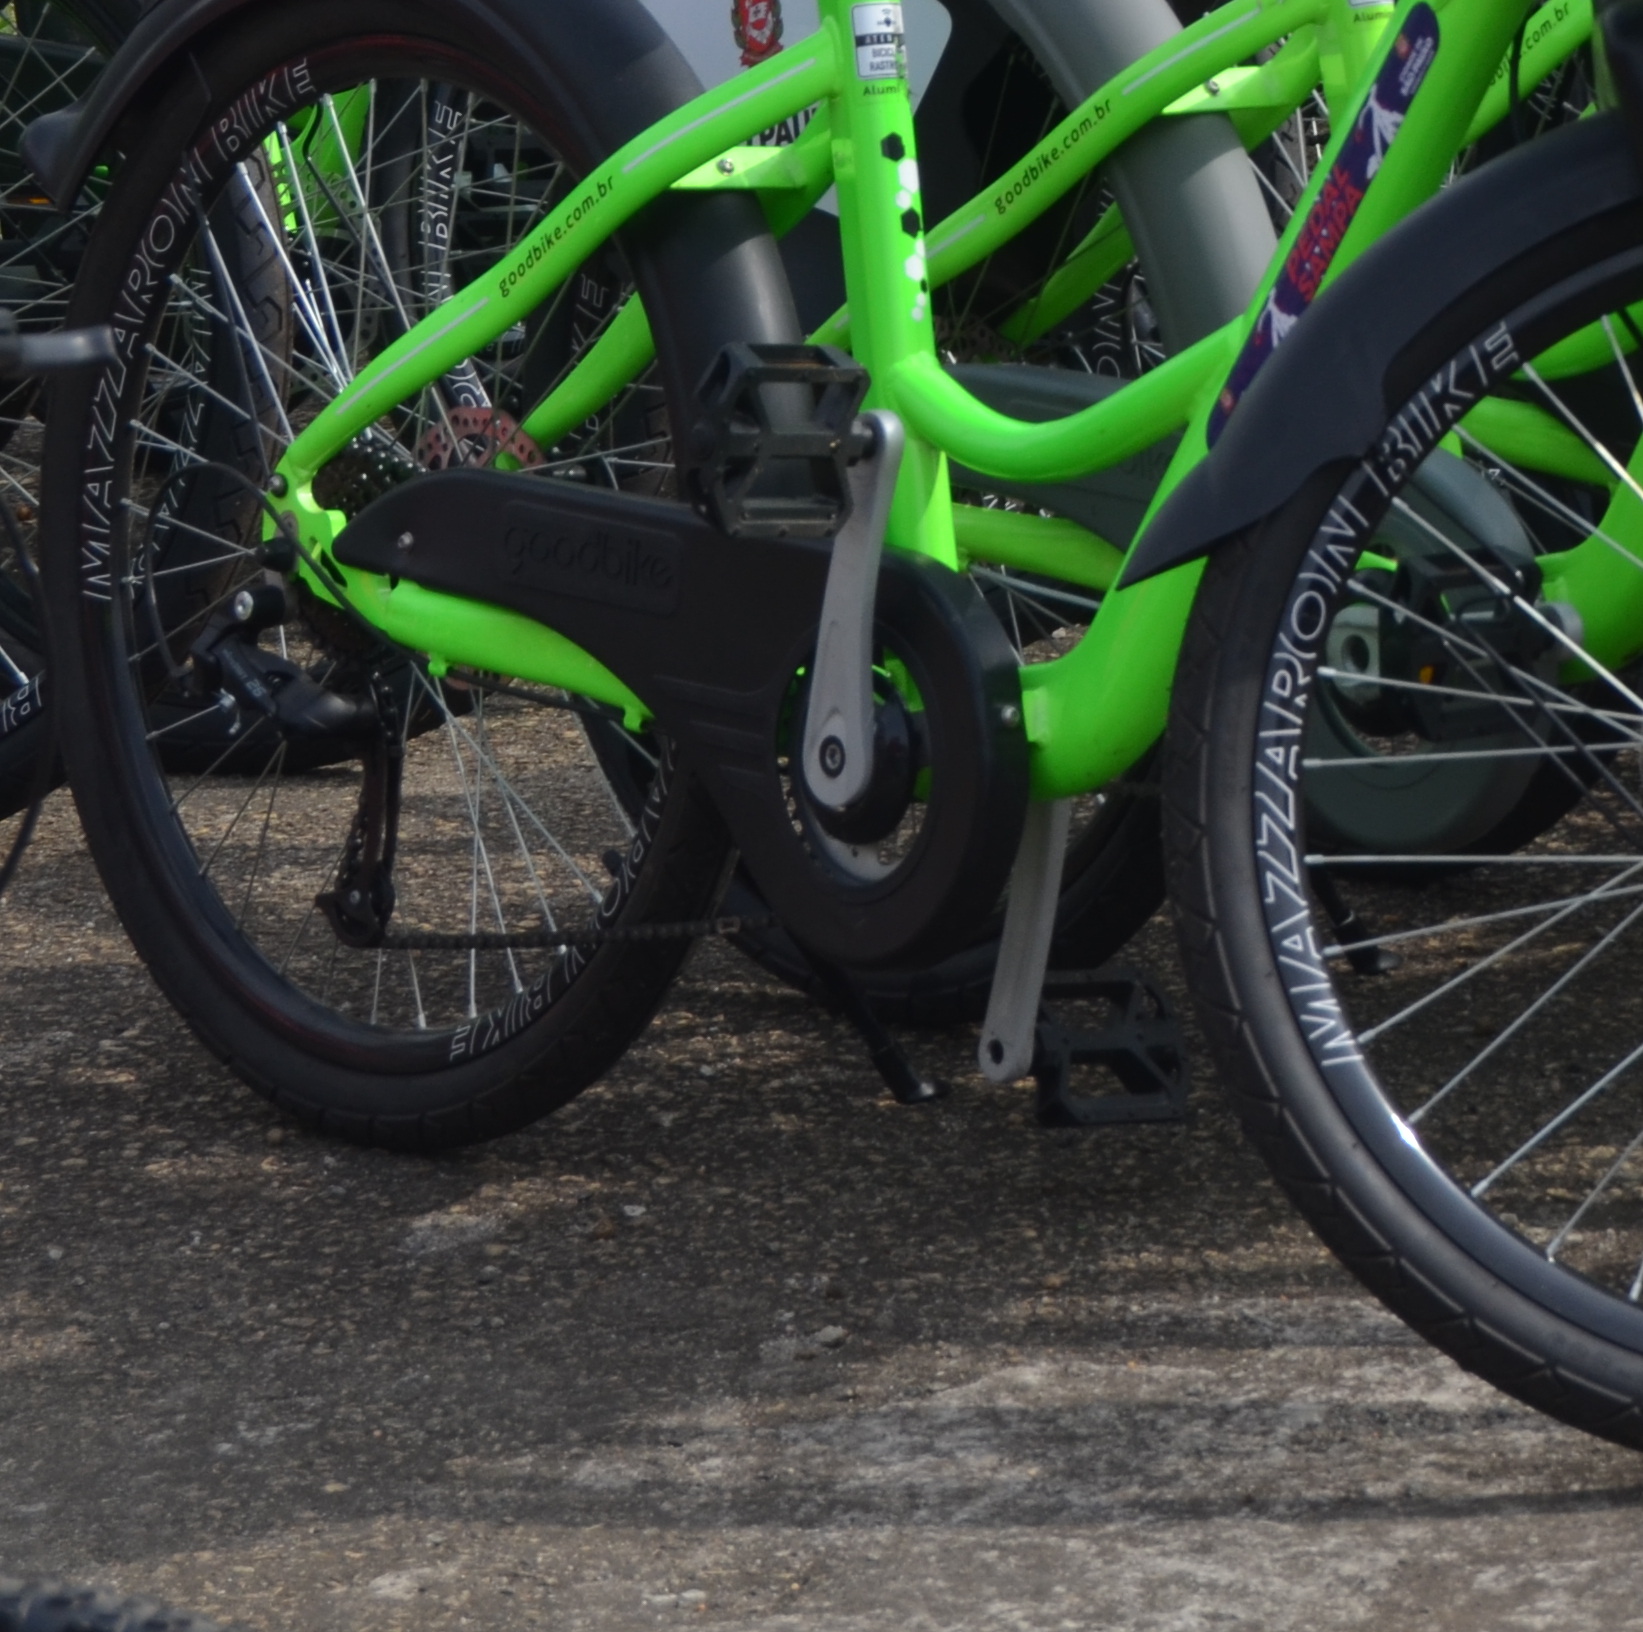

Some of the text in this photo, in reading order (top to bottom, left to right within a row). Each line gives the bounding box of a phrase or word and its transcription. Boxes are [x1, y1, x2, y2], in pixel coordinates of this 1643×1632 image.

[211, 55, 320, 163] BIKE
[994, 98, 1112, 216] goodbike.com.br
[498, 175, 616, 299] goodbike.com.br
[1364, 321, 1520, 498] BIKE
